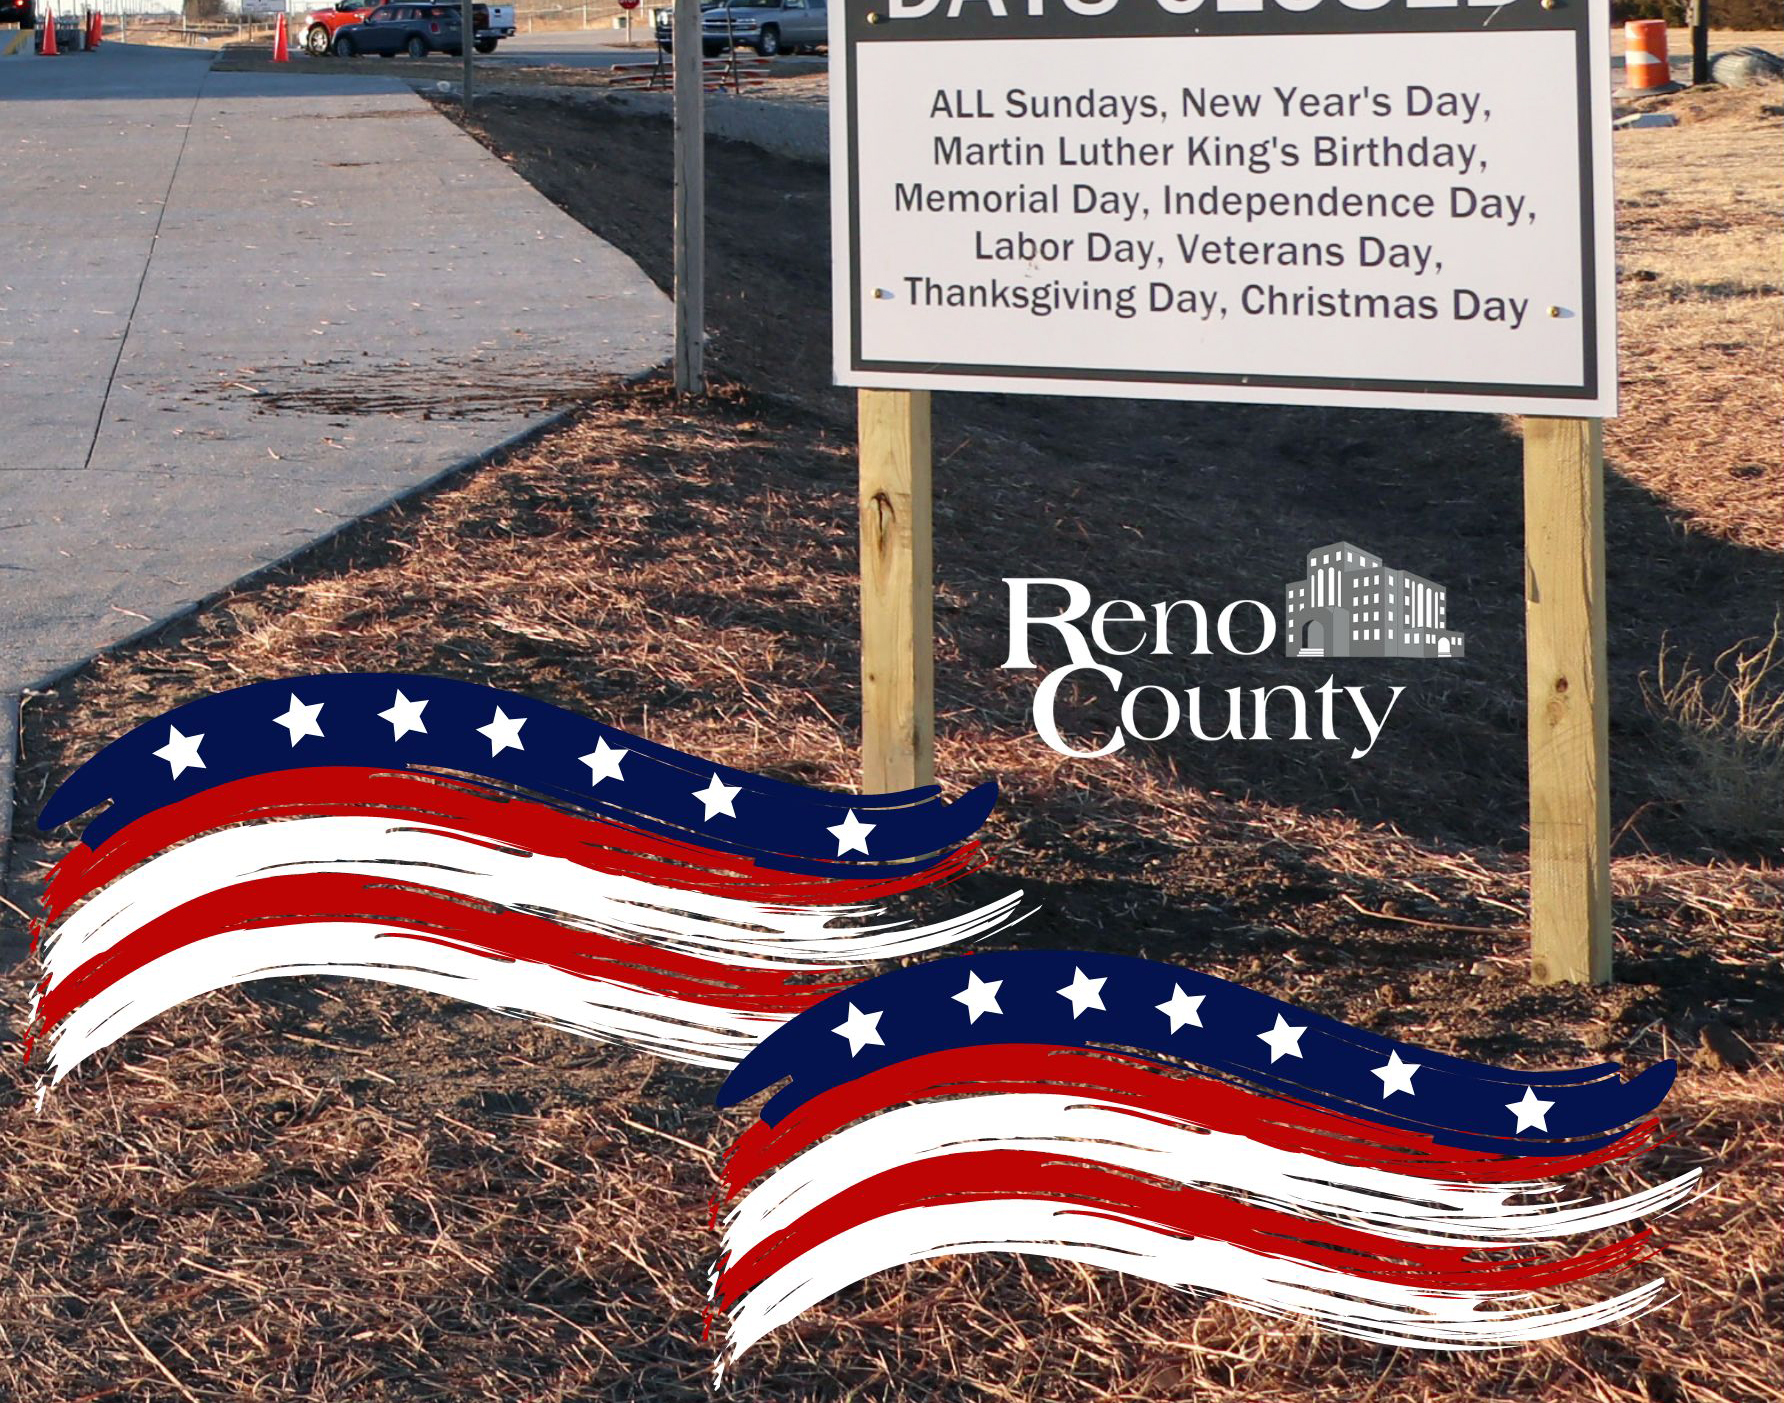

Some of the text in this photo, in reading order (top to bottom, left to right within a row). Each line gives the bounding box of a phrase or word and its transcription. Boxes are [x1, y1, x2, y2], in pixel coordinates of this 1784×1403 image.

[930, 86, 1490, 125] ALL Sundays, New Year's Day,
[935, 136, 1486, 175] Martin Luther King's Birthday,
[896, 183, 1535, 226] Memorial Day, Independence Day,
[976, 231, 1441, 275] Labor Day, Veterans Day,
[904, 277, 1528, 329] Thanksgiving Day, Christmas Day
